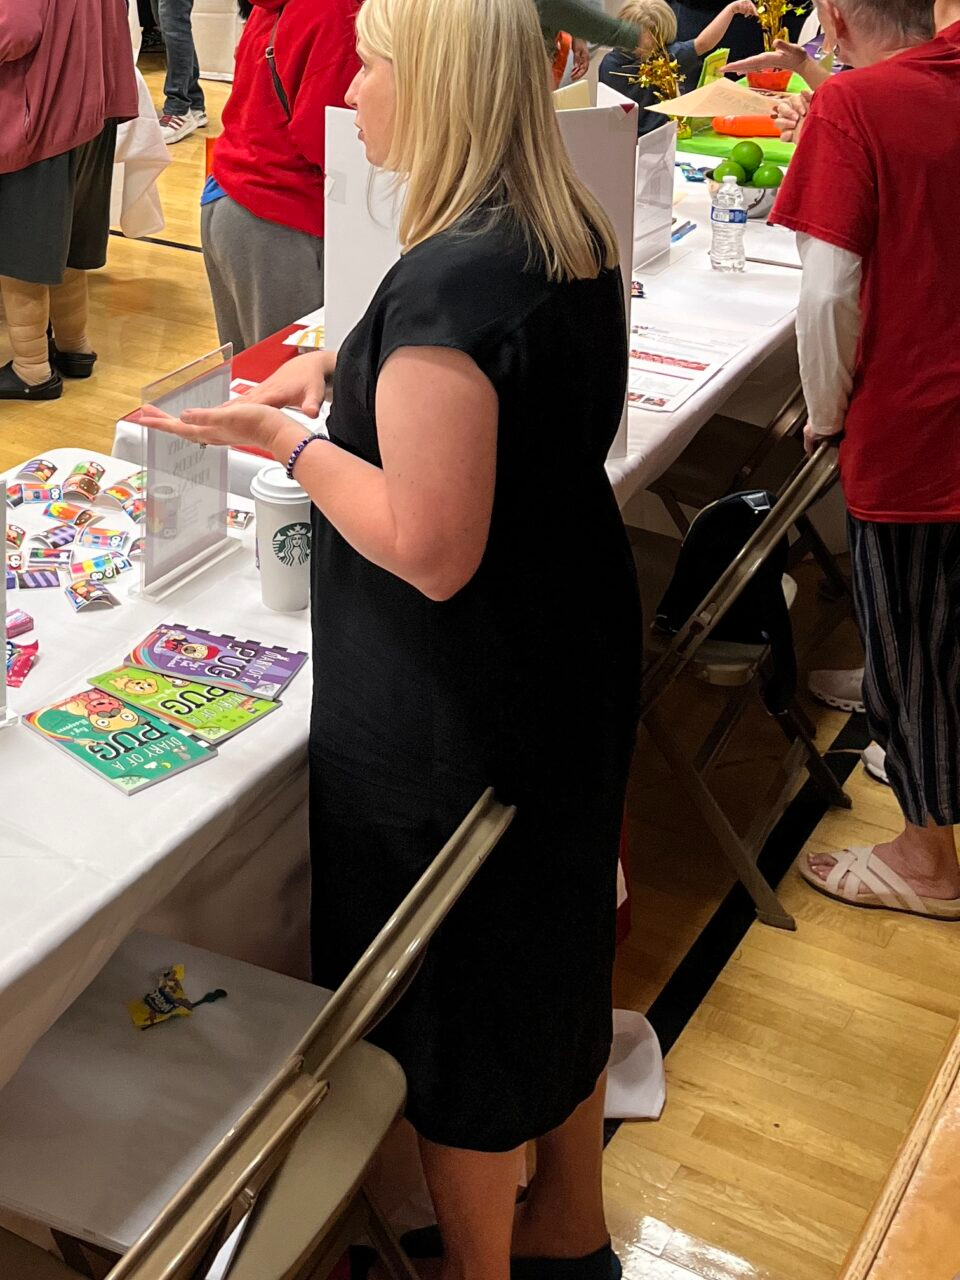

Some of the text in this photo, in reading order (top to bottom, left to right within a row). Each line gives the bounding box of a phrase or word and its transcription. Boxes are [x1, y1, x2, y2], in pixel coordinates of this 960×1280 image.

[204, 642, 258, 681] PUG
[159, 686, 226, 716] PUG
[84, 721, 171, 763] PUG
[111, 735, 183, 772] DIARY OF A
